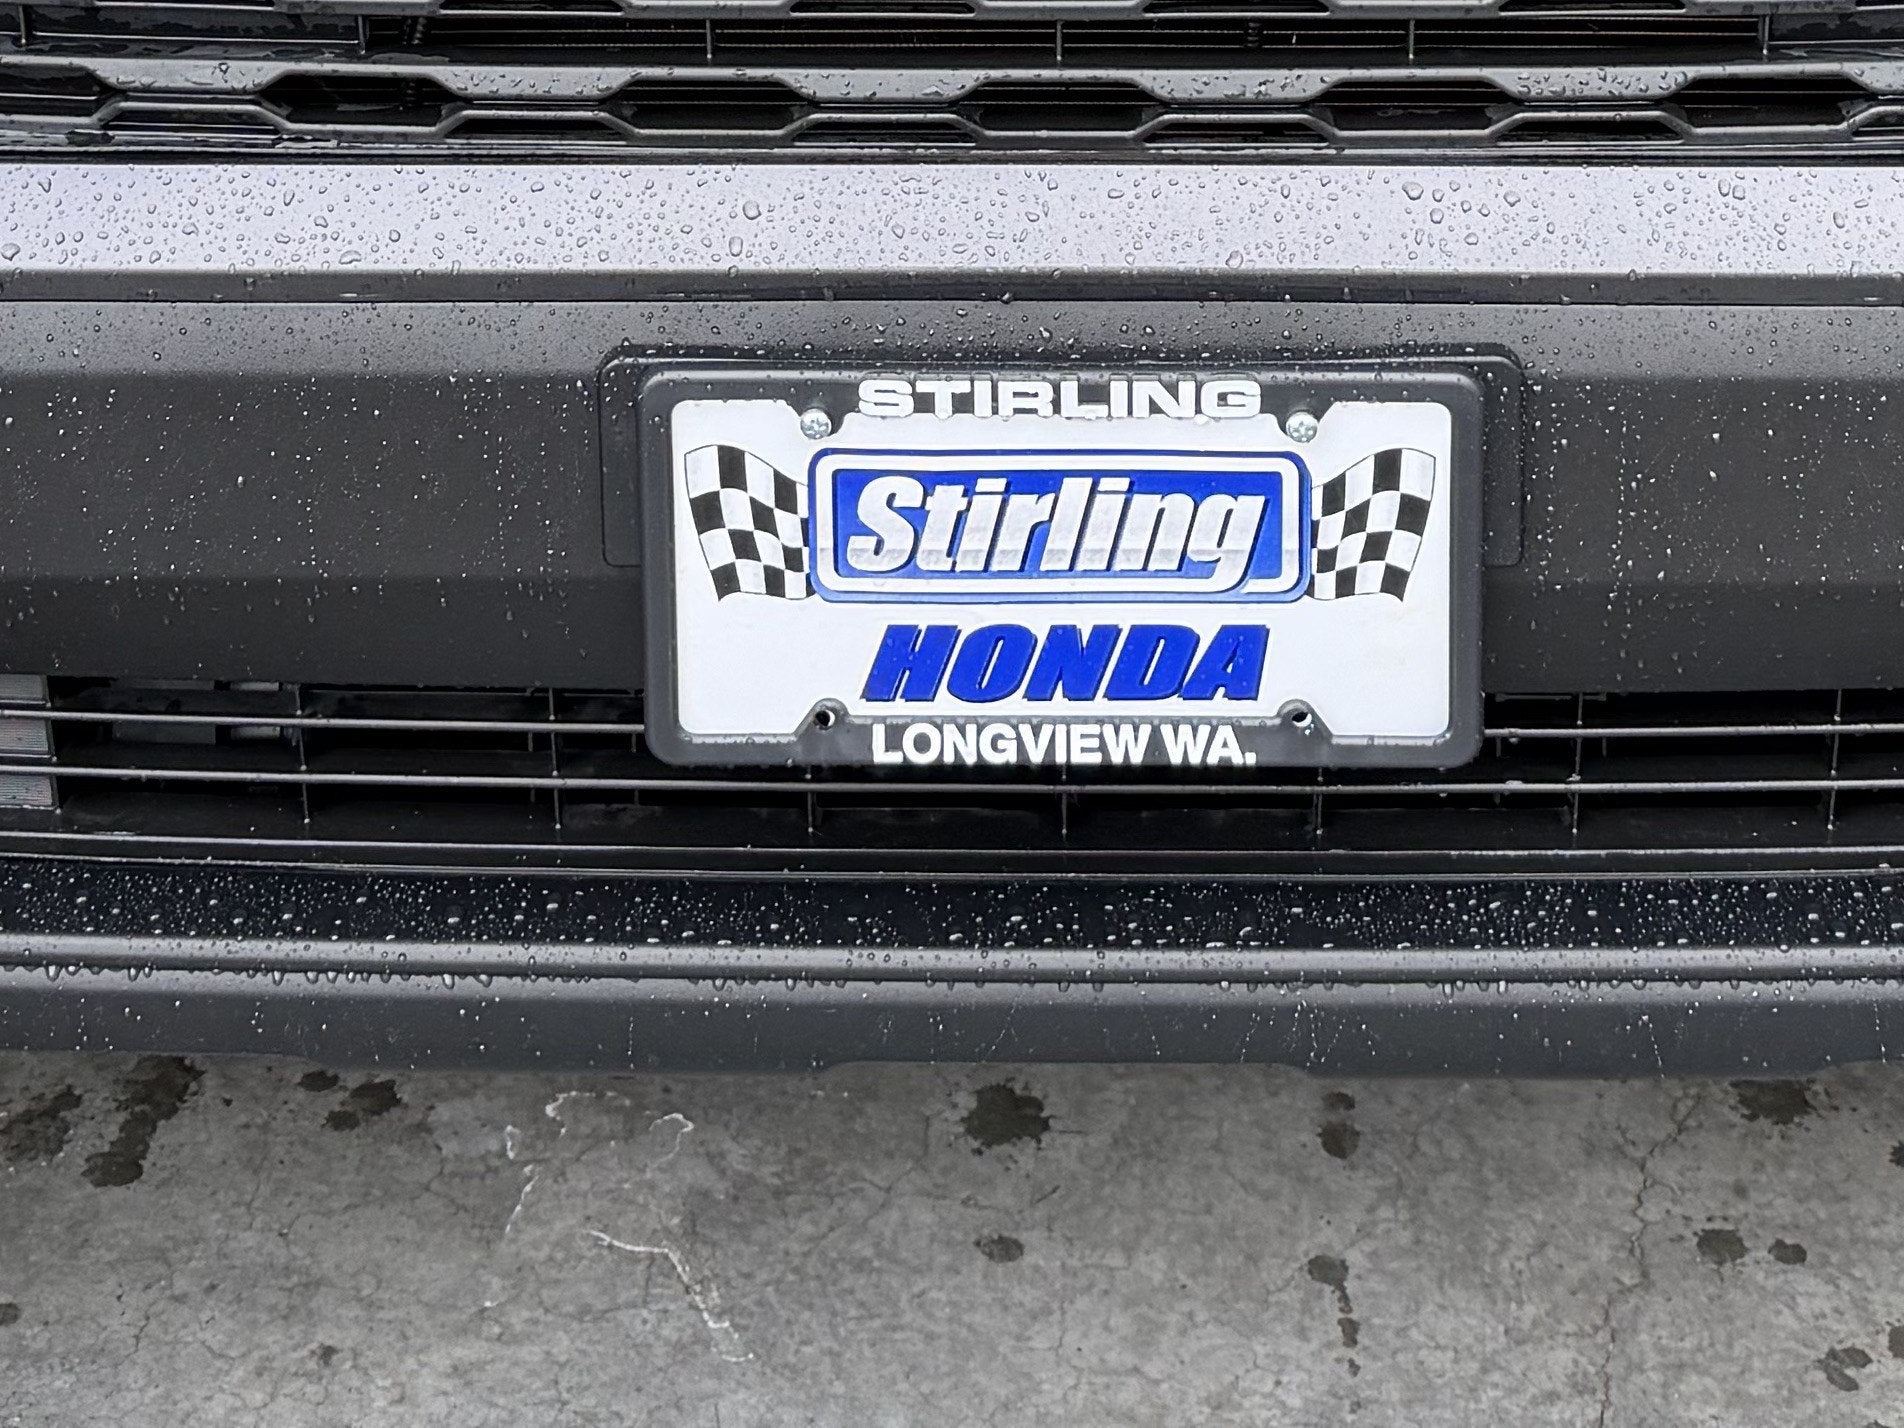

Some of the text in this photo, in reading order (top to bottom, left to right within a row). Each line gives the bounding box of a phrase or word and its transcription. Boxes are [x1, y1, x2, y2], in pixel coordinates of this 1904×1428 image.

[858, 379, 1262, 418] STIRLING
[846, 475, 1267, 591] Stirling
[862, 624, 1270, 702] HONDA
[872, 723, 1256, 764] LONGVIEW WA.
